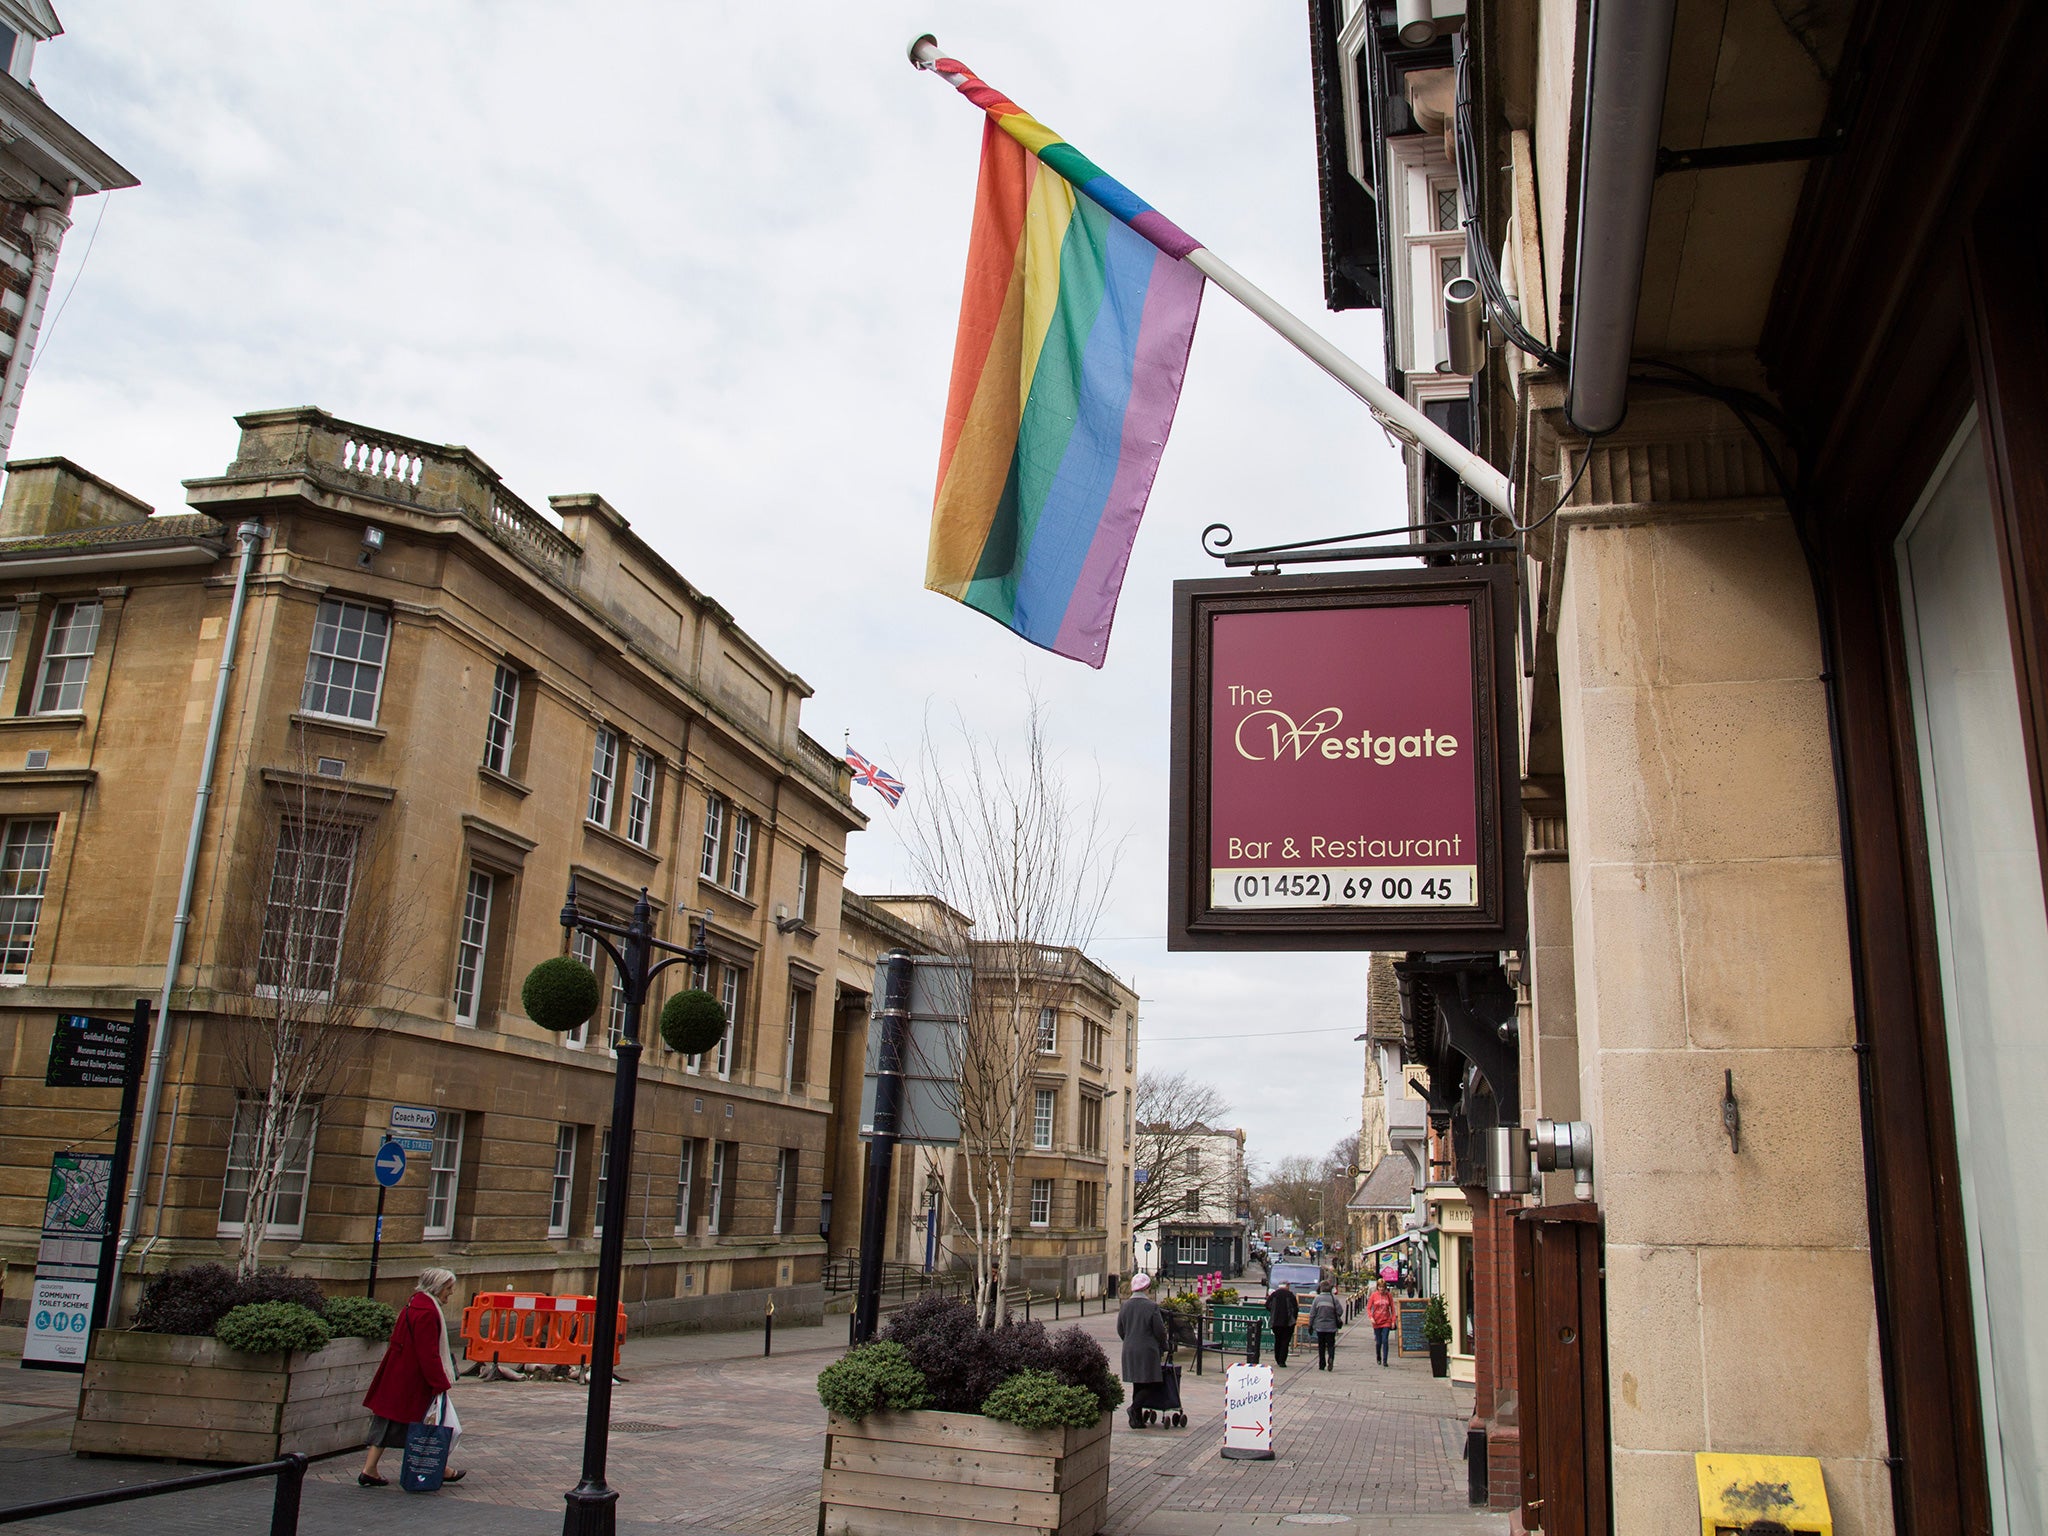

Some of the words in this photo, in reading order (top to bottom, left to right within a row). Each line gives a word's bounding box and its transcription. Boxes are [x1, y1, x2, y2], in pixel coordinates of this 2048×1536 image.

[1228, 685, 1273, 706] The
[1235, 707, 1459, 766] Westgate
[1229, 836, 1273, 859] Bar
[1281, 837, 1301, 859] &
[1311, 834, 1462, 858] Restaurant
[1233, 874, 1331, 902] (01452)
[1342, 877, 1373, 899] 69
[1381, 877, 1413, 899] 00
[1420, 877, 1452, 899] 45
[107, 1022, 116, 1032] City
[83, 1031, 104, 1041] Guildhall
[77, 1045, 96, 1055] Museum
[96, 1048, 106, 1056] and
[106, 1048, 126, 1059] Libraries
[70, 1057, 80, 1066] Bus
[79, 1058, 90, 1067] and
[89, 1059, 107, 1070] Railway
[91, 1073, 108, 1083] Leisure
[108, 1075, 123, 1085] Centre
[394, 1111, 415, 1122] Coach
[416, 1114, 431, 1124] Park
[39, 1291, 81, 1300] COMMUNITY
[39, 1300, 61, 1308] TOILET
[62, 1301, 89, 1310] SCHEME
[1238, 1374, 1261, 1389] The
[1230, 1390, 1268, 1410] Barbers
